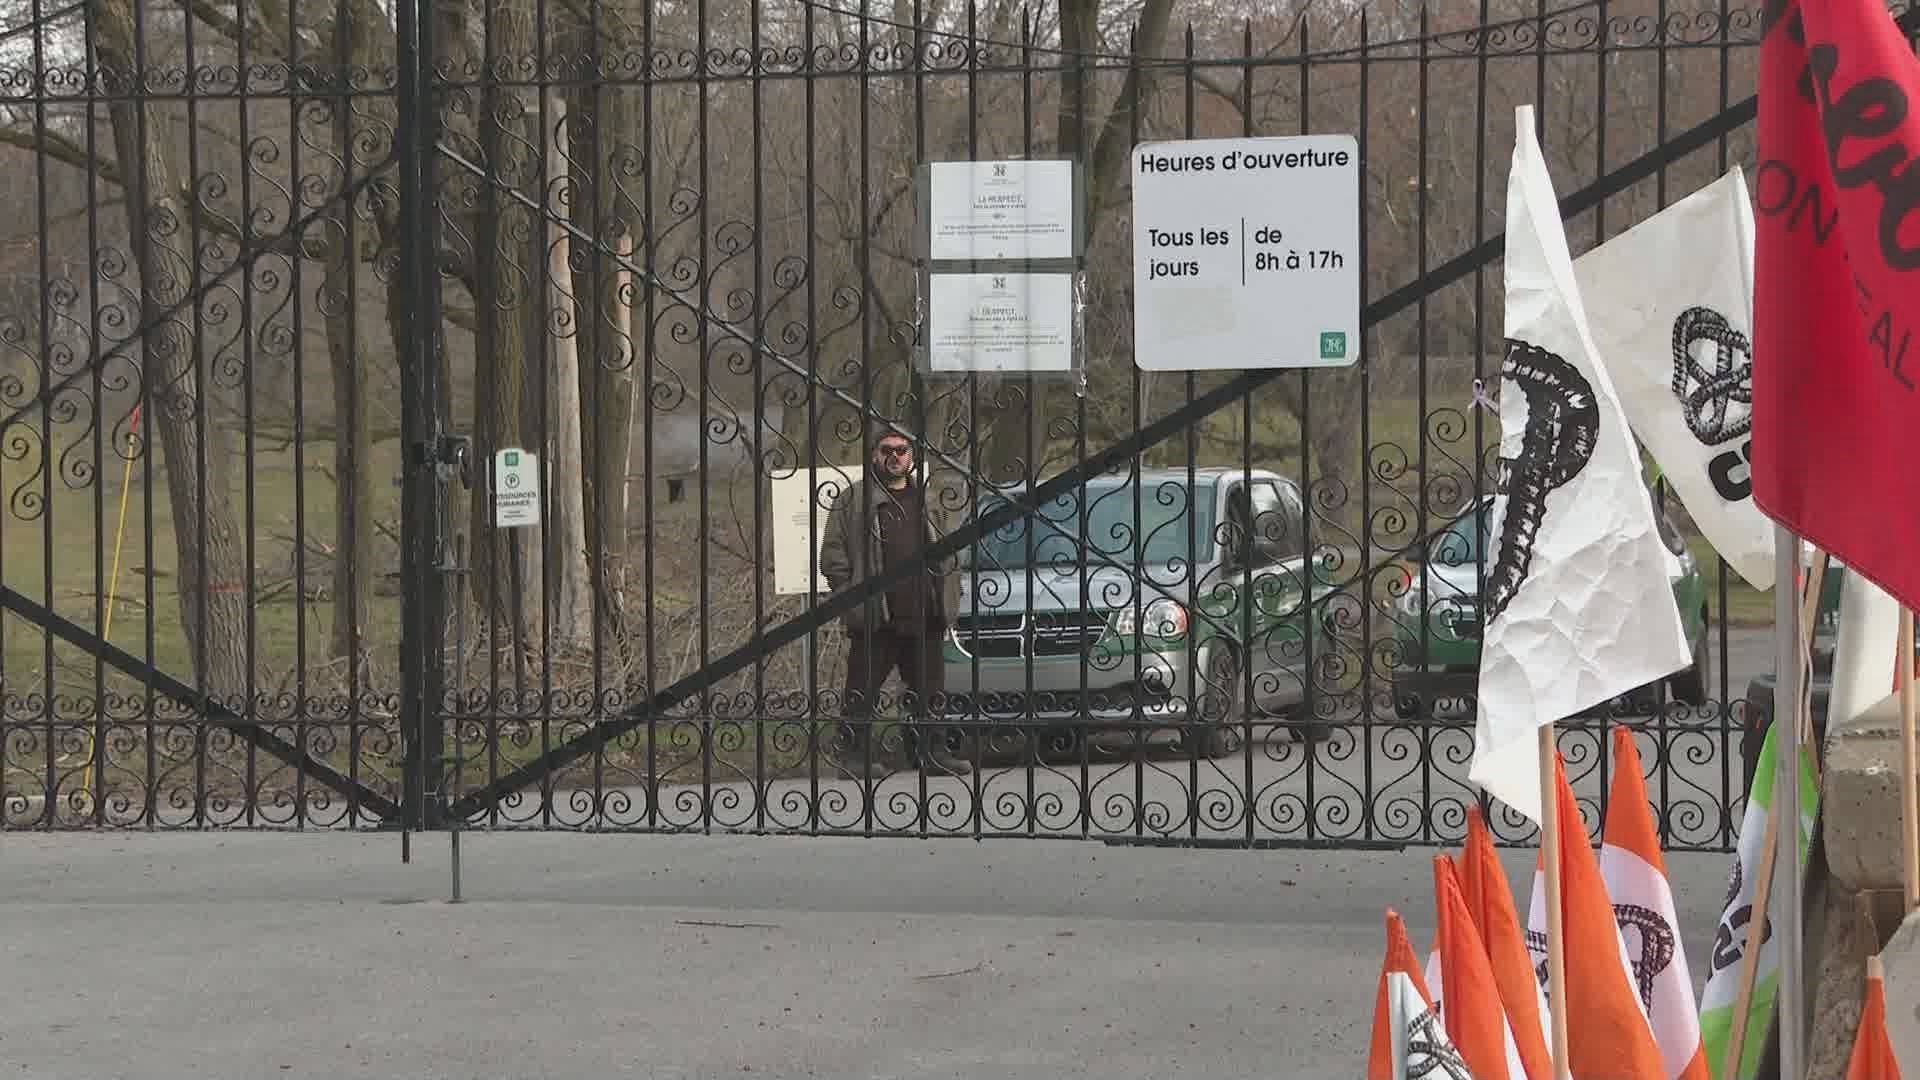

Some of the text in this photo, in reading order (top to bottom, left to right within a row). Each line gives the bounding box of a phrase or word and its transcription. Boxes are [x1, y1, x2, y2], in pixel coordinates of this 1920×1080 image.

[1140, 148, 1349, 173] Heures d'ouverture
[1148, 227, 1229, 247] Tous les
[1254, 226, 1283, 245] de
[1149, 258, 1199, 281] jours
[1255, 249, 1344, 271] 8h à 17h
